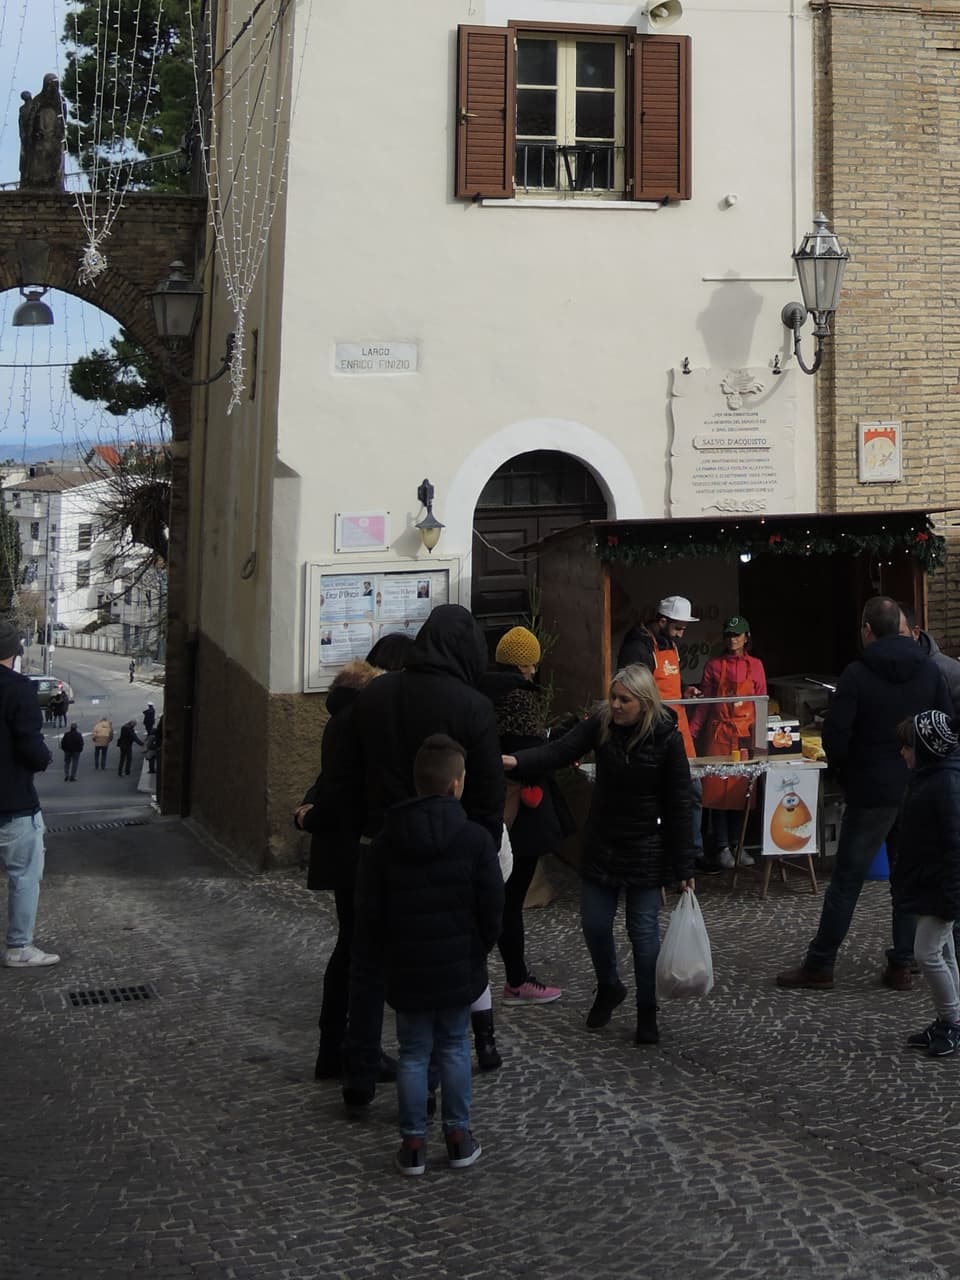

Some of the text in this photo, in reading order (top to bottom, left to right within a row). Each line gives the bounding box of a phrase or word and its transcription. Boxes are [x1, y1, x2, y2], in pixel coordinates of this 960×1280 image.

[361, 347, 390, 357] LARGO
[341, 359, 410, 370] ENRICO FINIZIO
[702, 438, 767, 446] SALVO D'ACQUISTO
